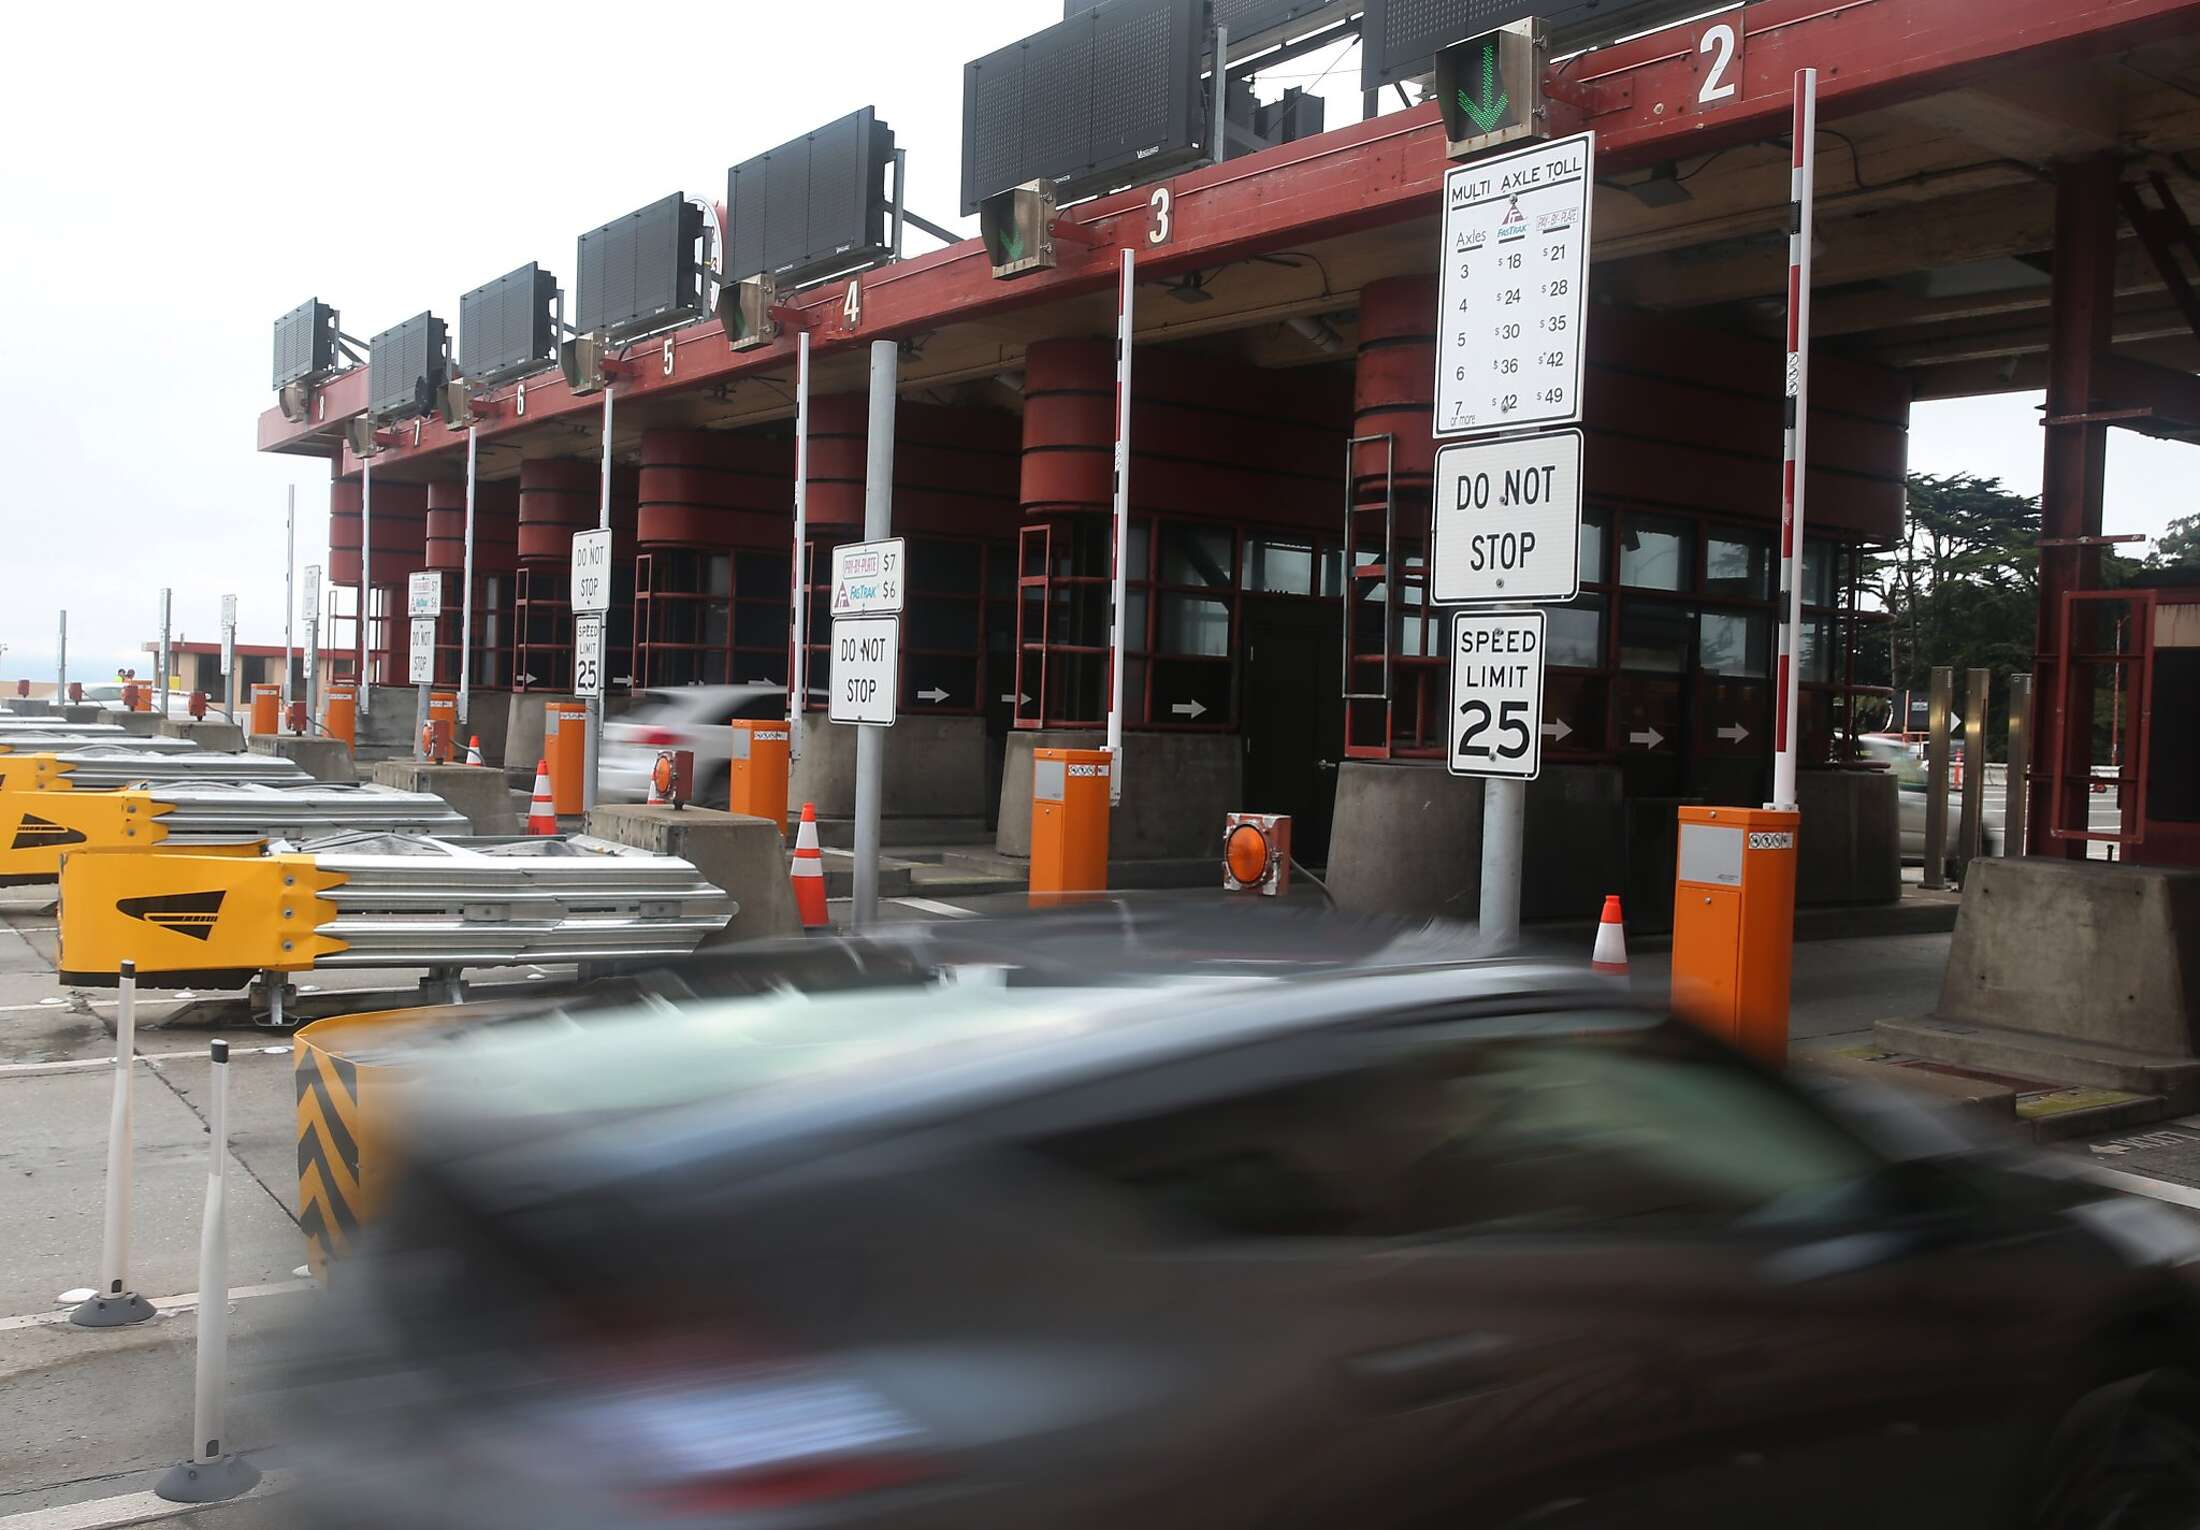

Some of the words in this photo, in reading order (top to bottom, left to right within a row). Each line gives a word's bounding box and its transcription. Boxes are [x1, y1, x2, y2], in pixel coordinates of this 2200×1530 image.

[1698, 24, 1736, 103] 2
[1451, 179, 1490, 203] MULTI
[1501, 167, 1541, 193] AXLE
[1546, 157, 1582, 178] TOLL
[1148, 187, 1171, 244] 3
[1456, 229, 1487, 247] Axles
[1460, 264, 1469, 279] 3
[844, 280, 859, 323] 4
[1459, 299, 1467, 313] 4
[1457, 333, 1466, 347] 5
[663, 338, 673, 375] 5
[1456, 366, 1465, 381] 6
[517, 384, 524, 415] 6
[1455, 401, 1462, 415] 7
[1456, 473, 1490, 511] DO
[1504, 465, 1556, 506] NOT
[577, 548, 587, 567] DO
[590, 546, 604, 566] NOT
[883, 554, 896, 572] $7
[1470, 532, 1536, 571] STOP
[580, 578, 598, 597] STOP
[883, 581, 896, 599] $6
[578, 625, 597, 637] SPEED
[1461, 630, 1536, 653] SPEED
[579, 643, 596, 655] LIMIT
[841, 639, 856, 662] DO
[862, 638, 885, 662] NOT
[577, 660, 597, 689] 25
[1467, 665, 1528, 688] LIMIT
[847, 679, 876, 703] STOP
[1458, 700, 1530, 759] 25
